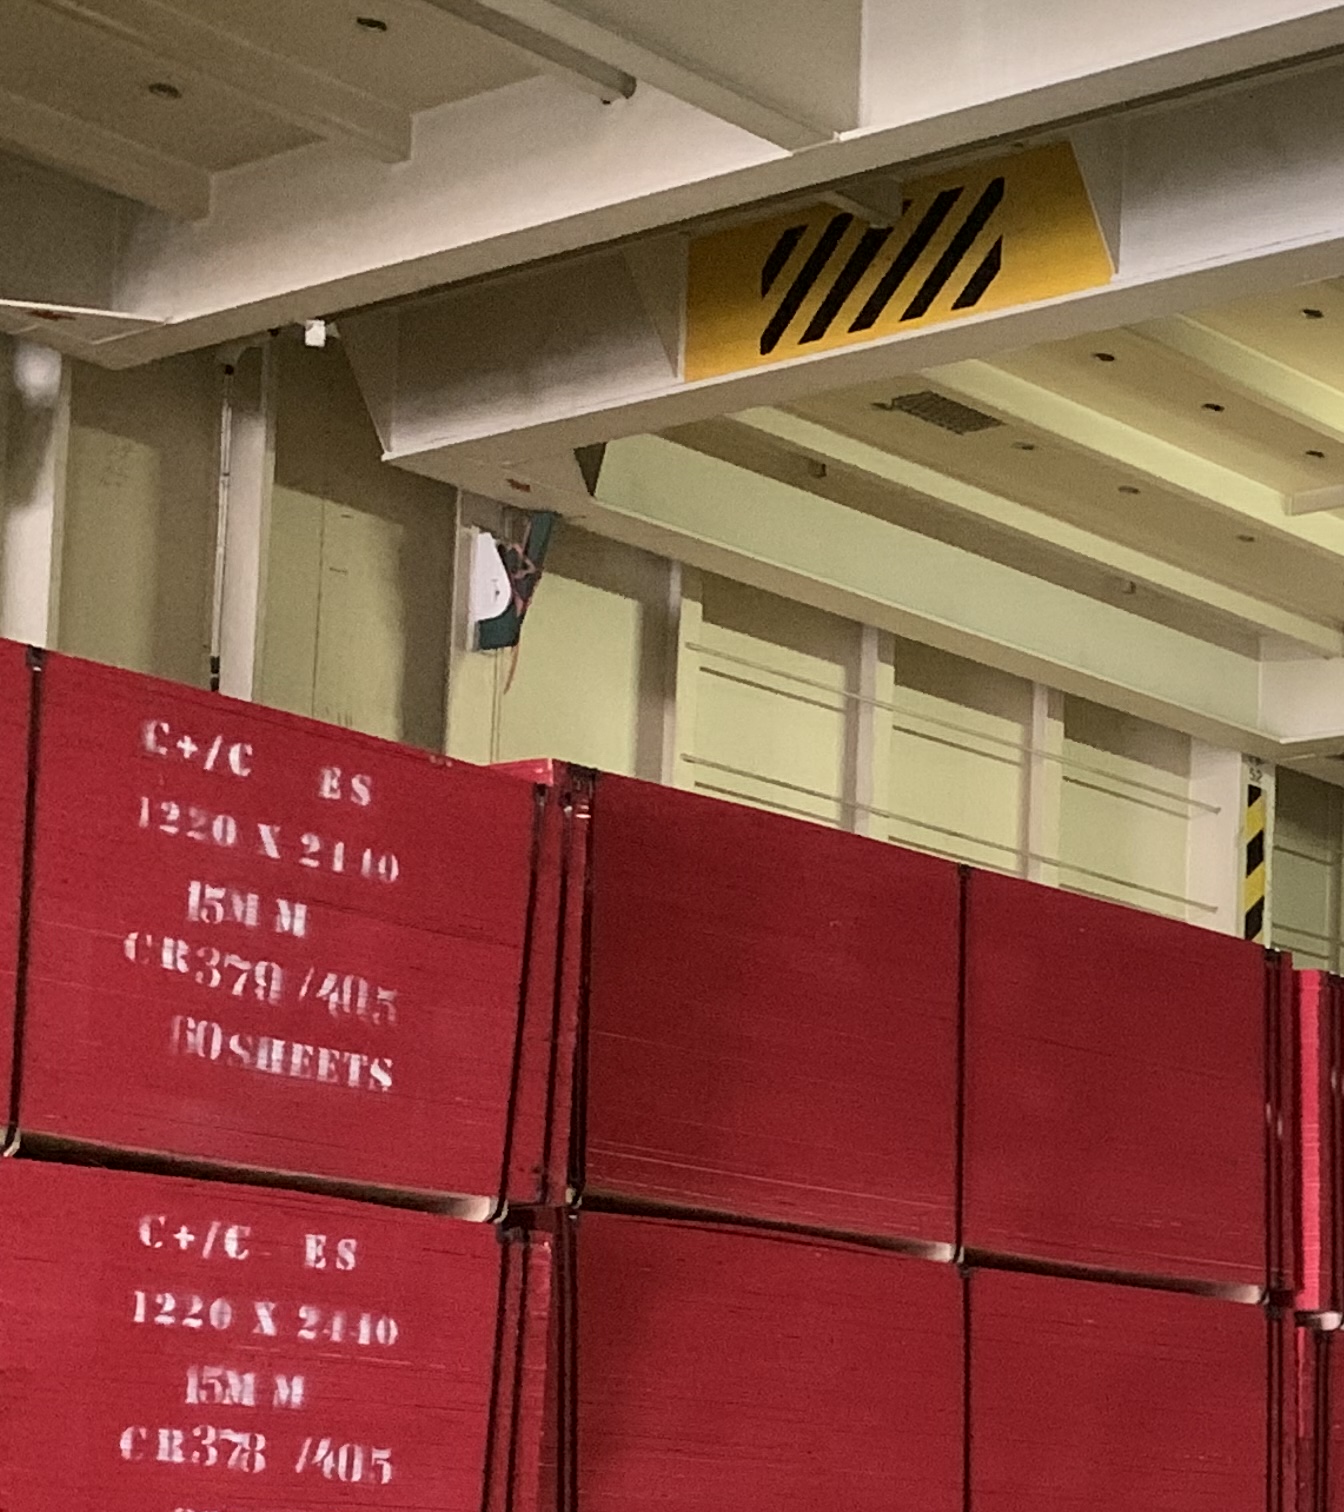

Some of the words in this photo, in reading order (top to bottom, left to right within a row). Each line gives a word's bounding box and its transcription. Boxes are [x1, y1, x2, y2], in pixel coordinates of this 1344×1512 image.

[318, 766, 372, 807] ES
[138, 797, 237, 847] 1220
[258, 822, 281, 859] X
[139, 1215, 253, 1261] C+/C
[305, 1232, 358, 1272] ES
[132, 1290, 233, 1330] 1220
[253, 1301, 278, 1337] X
